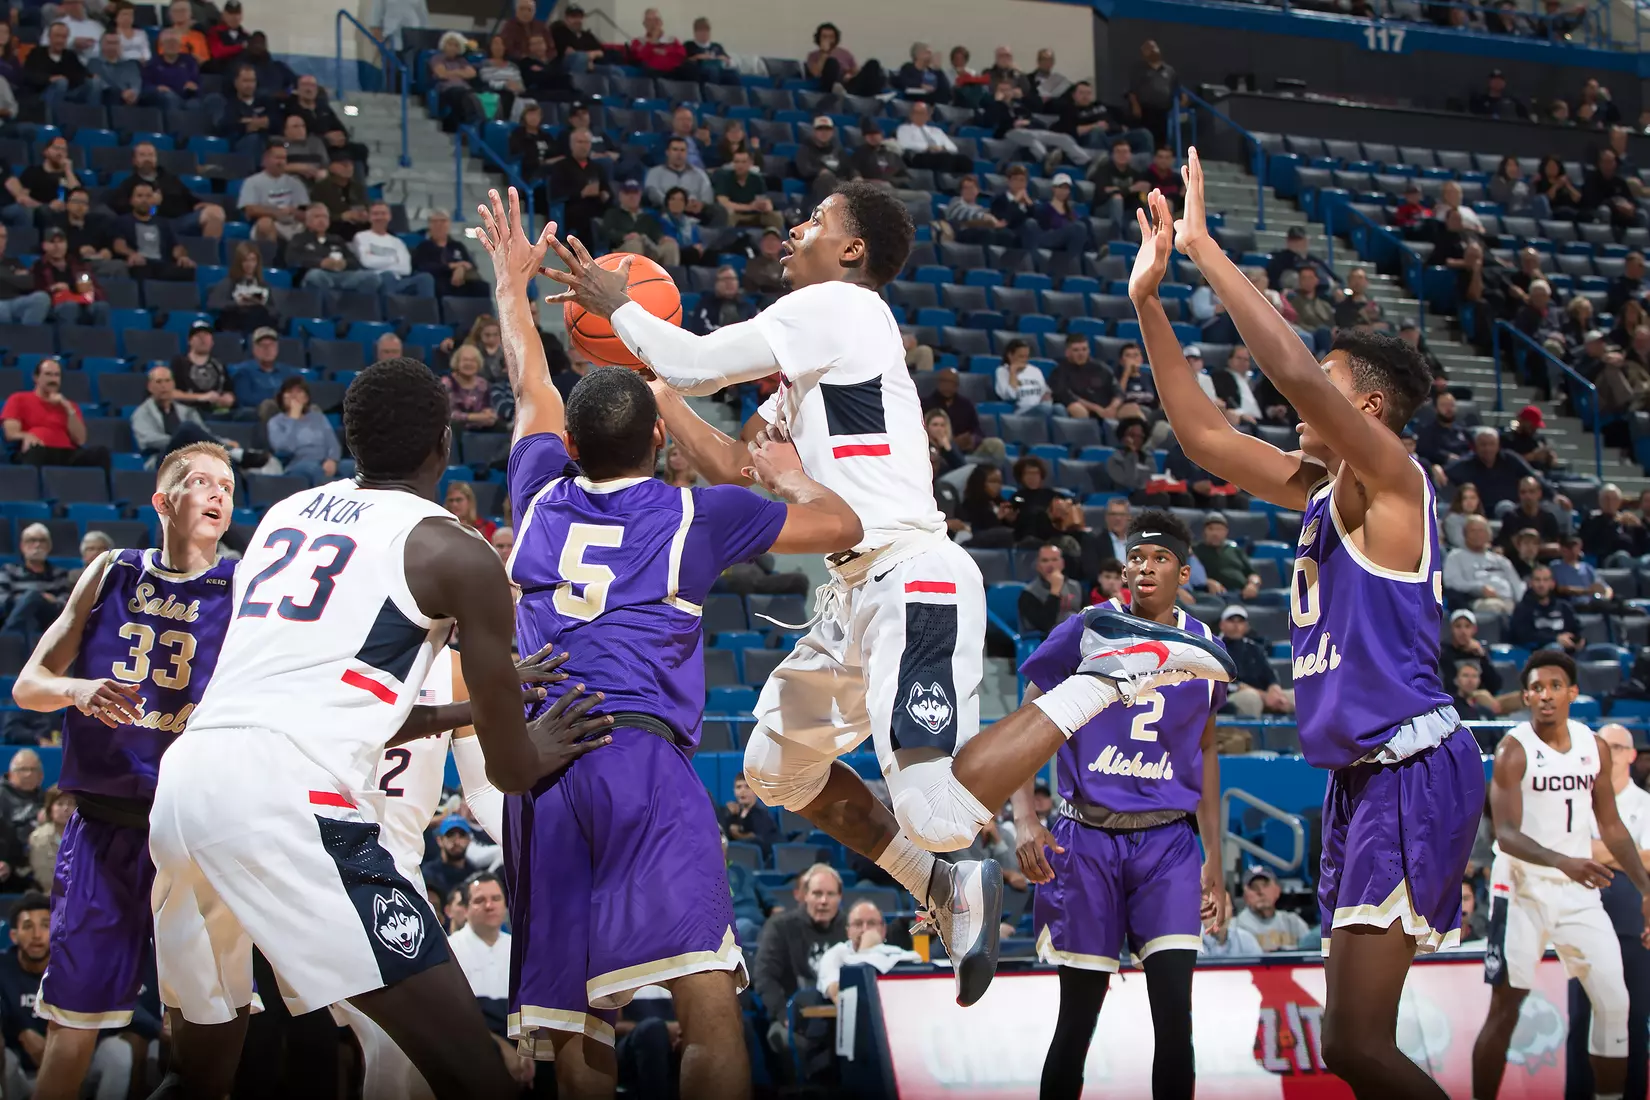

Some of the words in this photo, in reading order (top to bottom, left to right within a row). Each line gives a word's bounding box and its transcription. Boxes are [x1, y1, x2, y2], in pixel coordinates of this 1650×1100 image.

[1363, 26, 1406, 53] 117
[298, 492, 375, 525] AKOK
[236, 527, 358, 623] 23
[552, 522, 625, 622] 5
[1288, 556, 1321, 628] 0
[128, 582, 200, 623] Saint
[112, 621, 198, 691] 33
[1130, 690, 1166, 742] 2
[1565, 798, 1573, 833] 1
